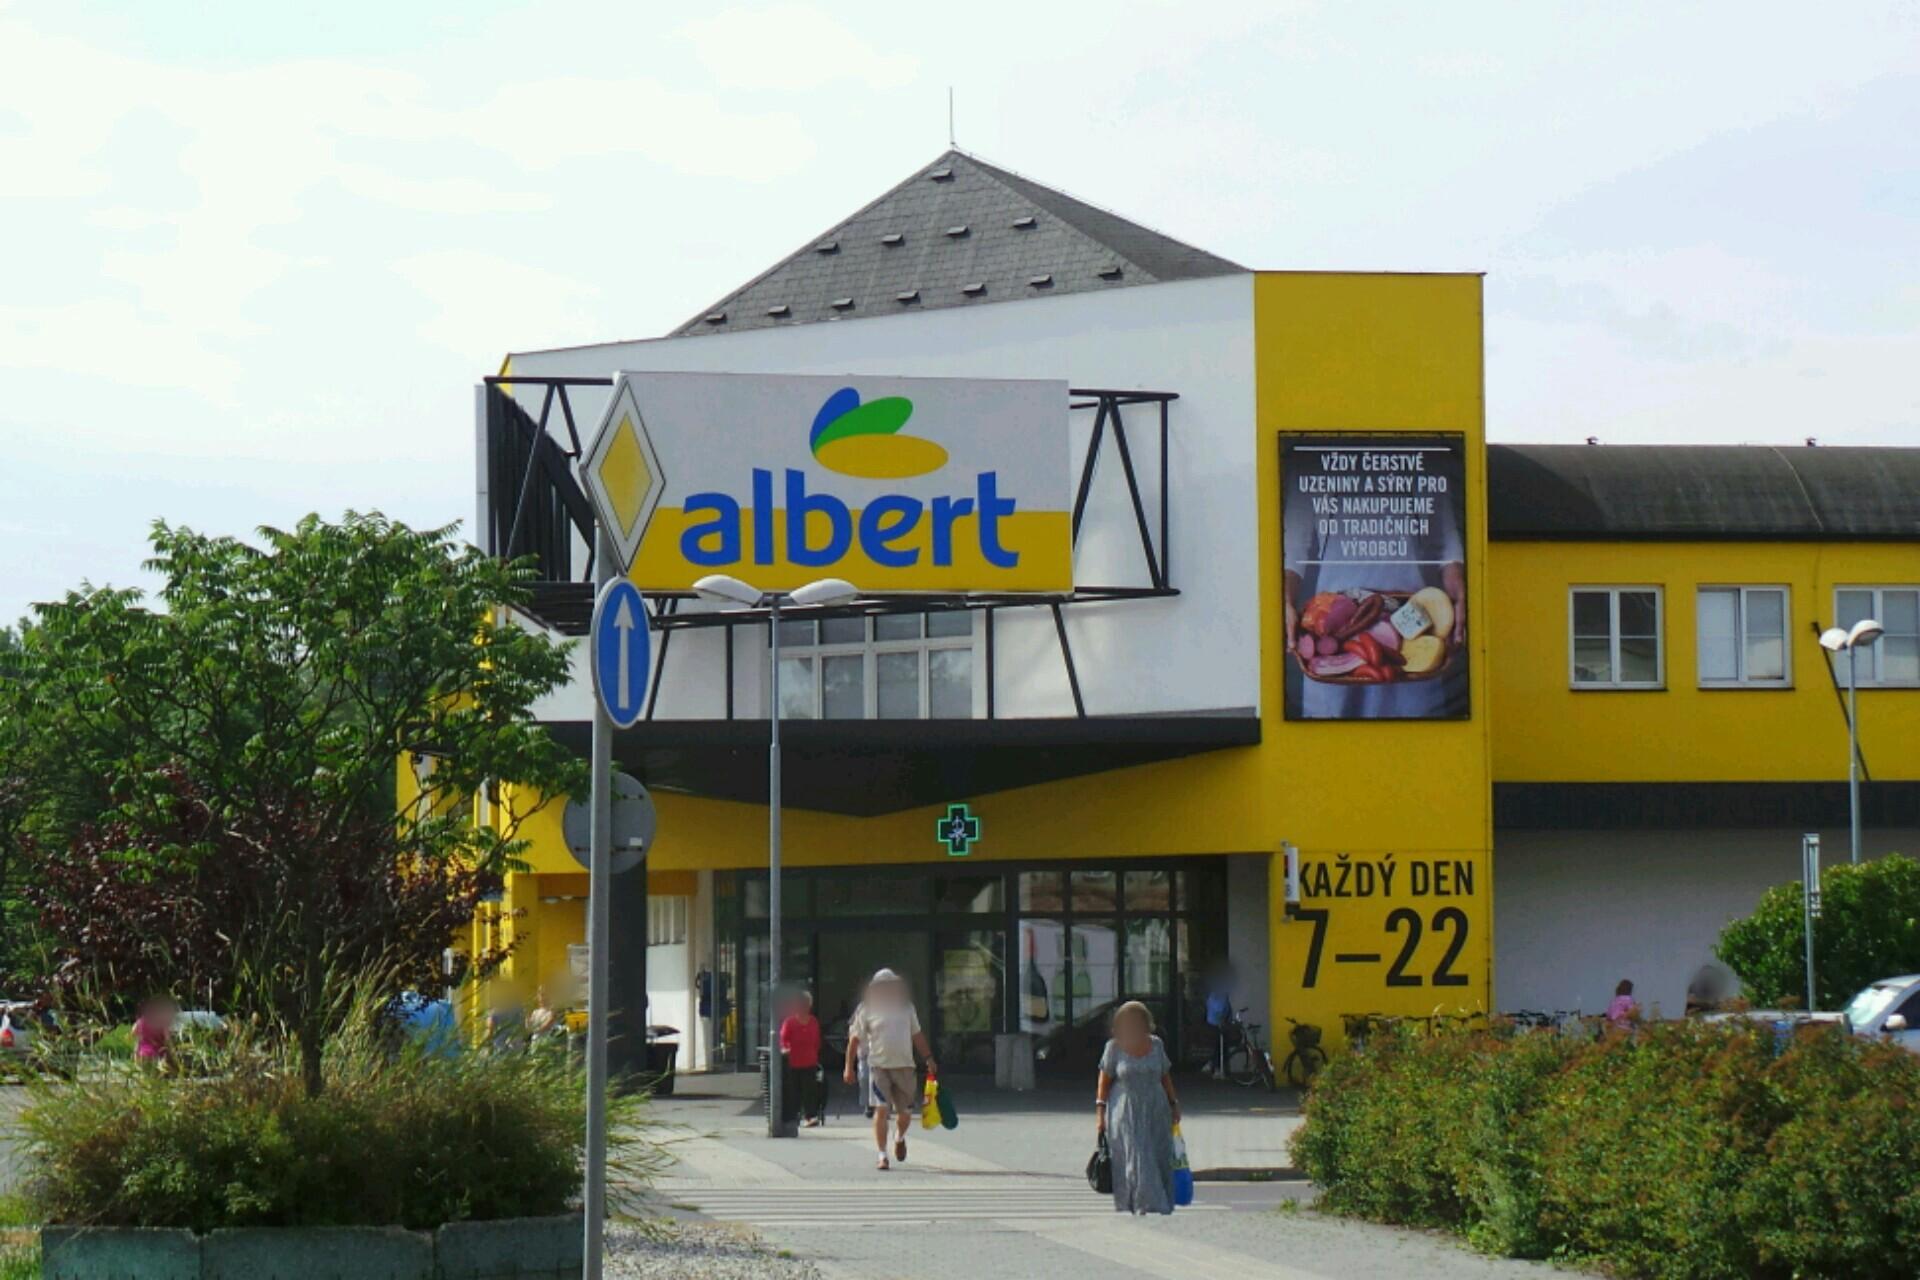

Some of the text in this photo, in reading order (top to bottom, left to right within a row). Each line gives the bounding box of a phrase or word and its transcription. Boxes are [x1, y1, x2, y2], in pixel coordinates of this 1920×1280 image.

[1321, 452, 1424, 471] VŽDY ČERSTVÉ
[1299, 473, 1447, 493] UZENINY A SÝRY PRO
[1312, 495, 1434, 514] VÁS NAKUPUJEME
[679, 467, 1019, 569] albert
[1319, 516, 1429, 535] OD TRADIČNÍCH
[1340, 538, 1407, 557] VÝROBCŮ
[1410, 861, 1473, 896] DEN
